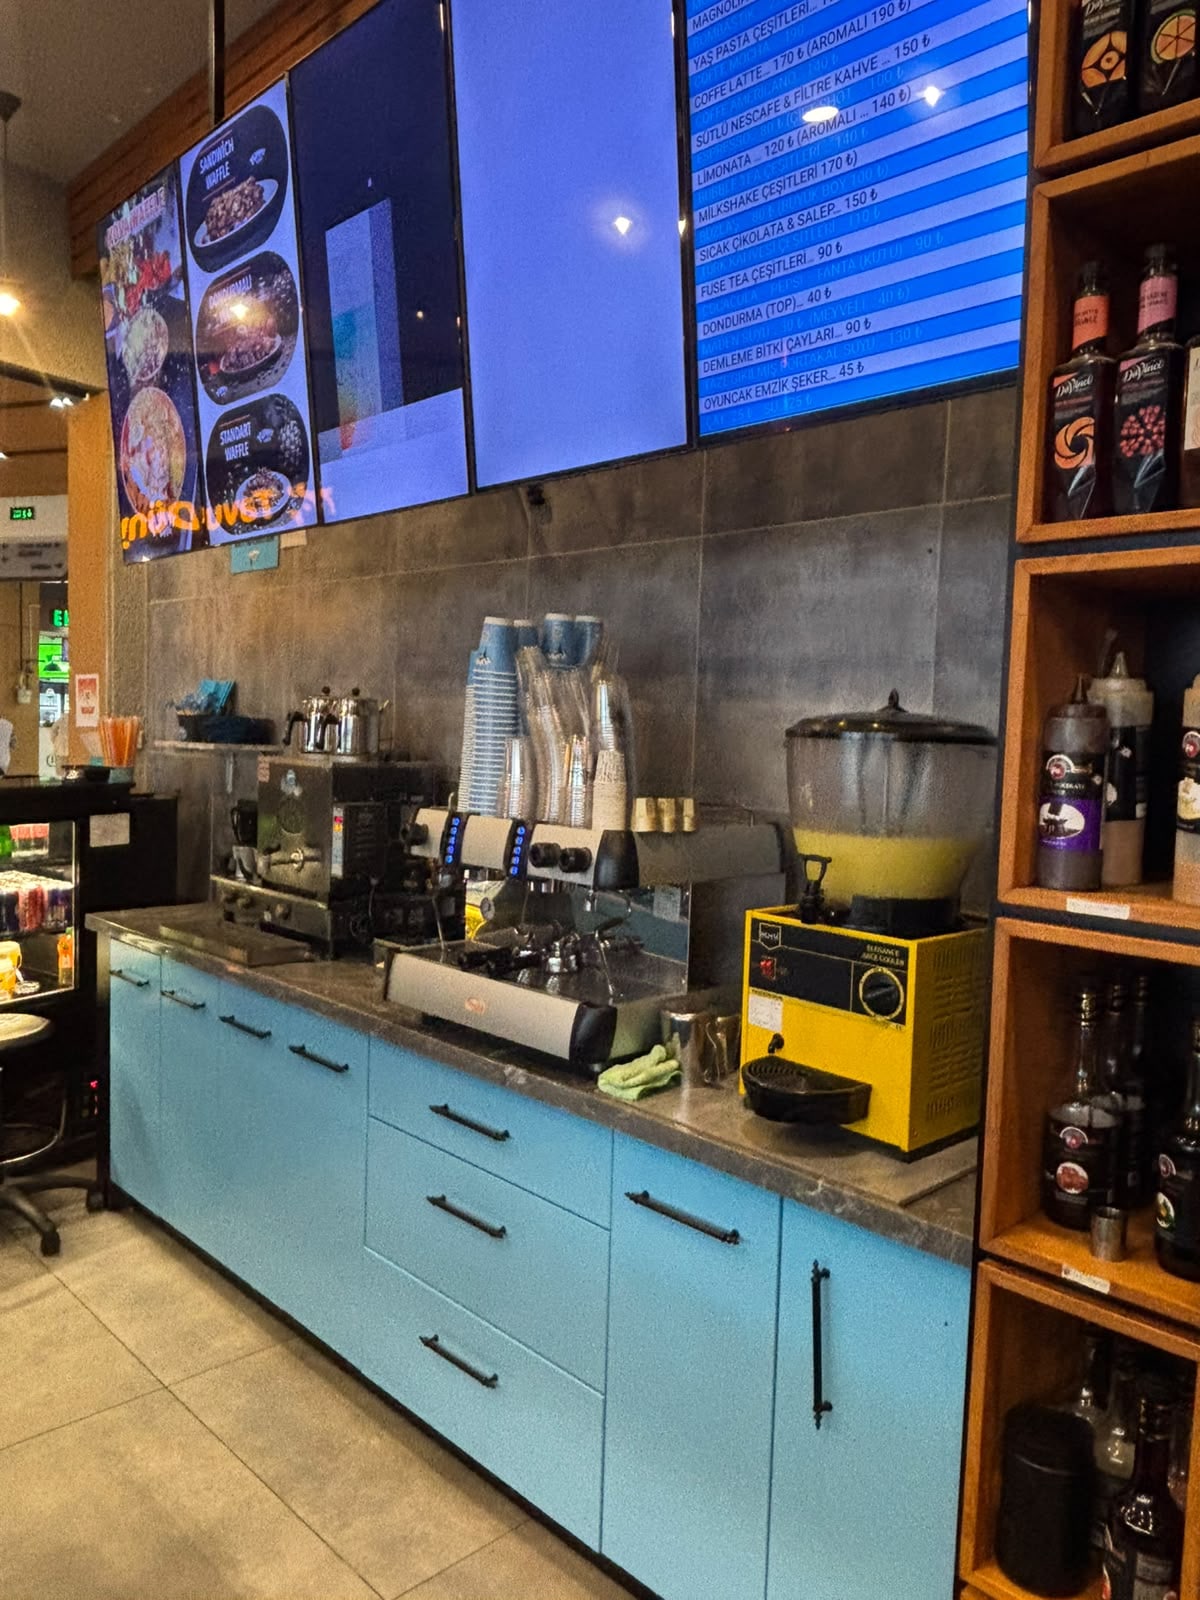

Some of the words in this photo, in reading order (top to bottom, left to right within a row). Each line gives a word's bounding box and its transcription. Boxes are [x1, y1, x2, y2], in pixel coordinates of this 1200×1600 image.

[694, 50, 712, 73] YAŞ
[716, 30, 749, 59] PASTA
[694, 82, 726, 109] COFFE
[774, 49, 794, 71] 170
[807, 13, 867, 57] (AROMALI
[872, 1, 894, 25] 190
[696, 118, 728, 148] SÜTLÜ
[731, 98, 780, 132] NESCAFE
[783, 93, 791, 109] &
[794, 72, 830, 104] FİLTRE
[835, 55, 877, 87] KAHVE
[894, 36, 918, 61] 150
[697, 149, 751, 185] LİMONATA
[765, 137, 784, 158] 120
[797, 106, 855, 146] (AROMALI
[872, 90, 895, 114] 140
[205, 161, 231, 191] WAFFLE
[698, 186, 758, 222] MİLKSHAKE
[762, 162, 817, 201] ÇEŞİTLERİ
[821, 154, 842, 176] 170
[700, 240, 729, 262] SICAK
[732, 218, 784, 254] ÇİKOLATA
[787, 216, 794, 230] &
[844, 189, 866, 211] 150
[701, 278, 725, 298] FUSE
[728, 270, 748, 289] TEA
[817, 242, 832, 260] 90
[703, 306, 762, 335] DONDURMA
[807, 288, 821, 304] 40
[703, 348, 753, 373] DEMLEME
[756, 337, 782, 359] BİTKİ
[845, 318, 860, 335] 90
[1124, 358, 1166, 382] DaVinci
[704, 387, 752, 410] OYUNCAK
[755, 375, 790, 398] EMZİK
[839, 361, 853, 378] 45
[1056, 374, 1095, 398] DaVinci
[220, 421, 252, 446] STANDART
[225, 441, 250, 462] WAFFLE
